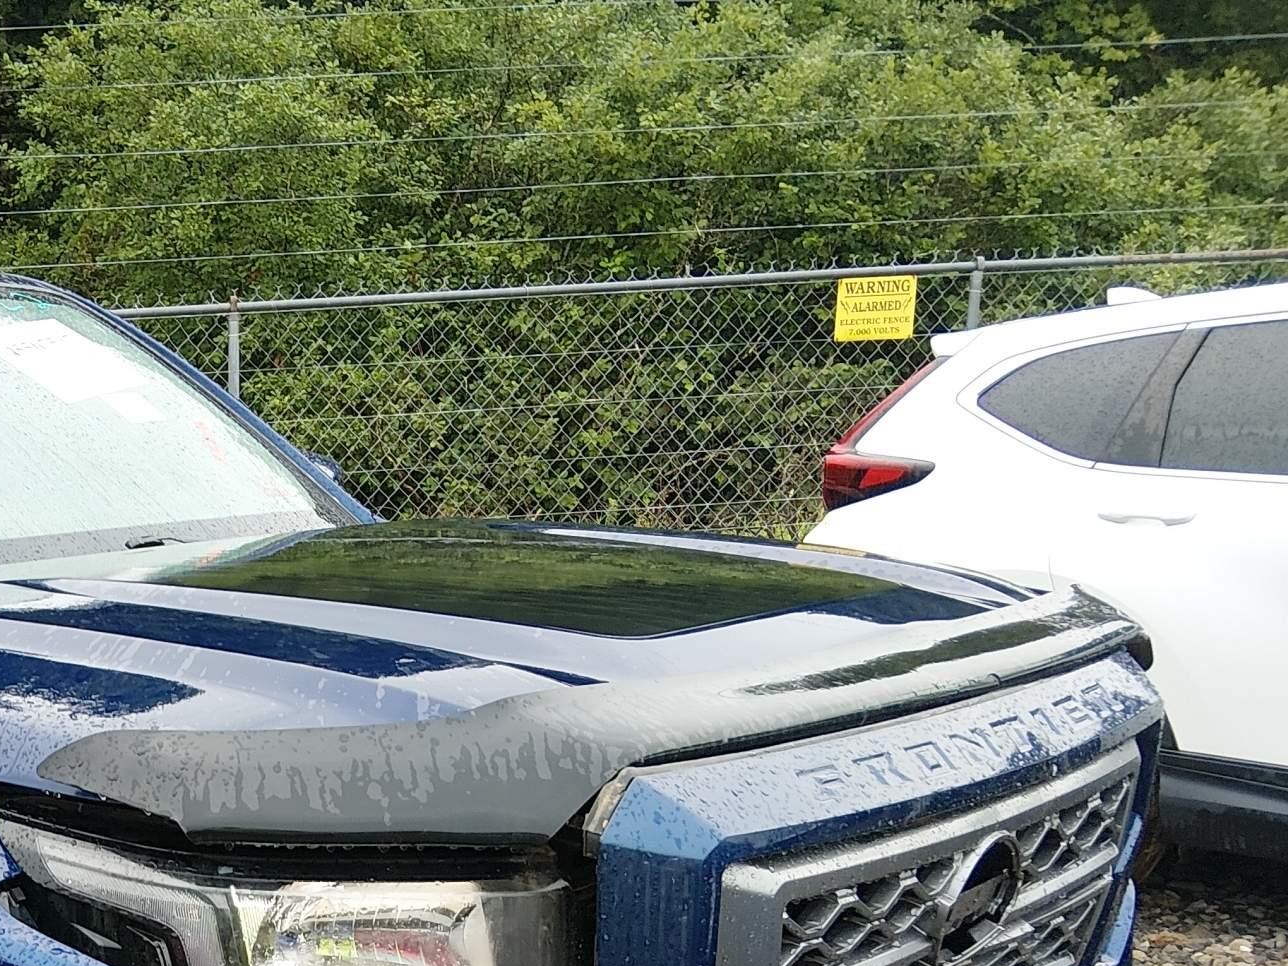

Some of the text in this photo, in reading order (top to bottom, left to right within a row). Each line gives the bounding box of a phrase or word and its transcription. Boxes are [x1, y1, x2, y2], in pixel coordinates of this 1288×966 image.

[845, 280, 911, 294] WARNING
[851, 300, 902, 312] ALARMED
[840, 316, 911, 326] ELECTRIC FENCE
[873, 326, 900, 335] VOLTS
[795, 681, 1142, 802] FRONTIER
